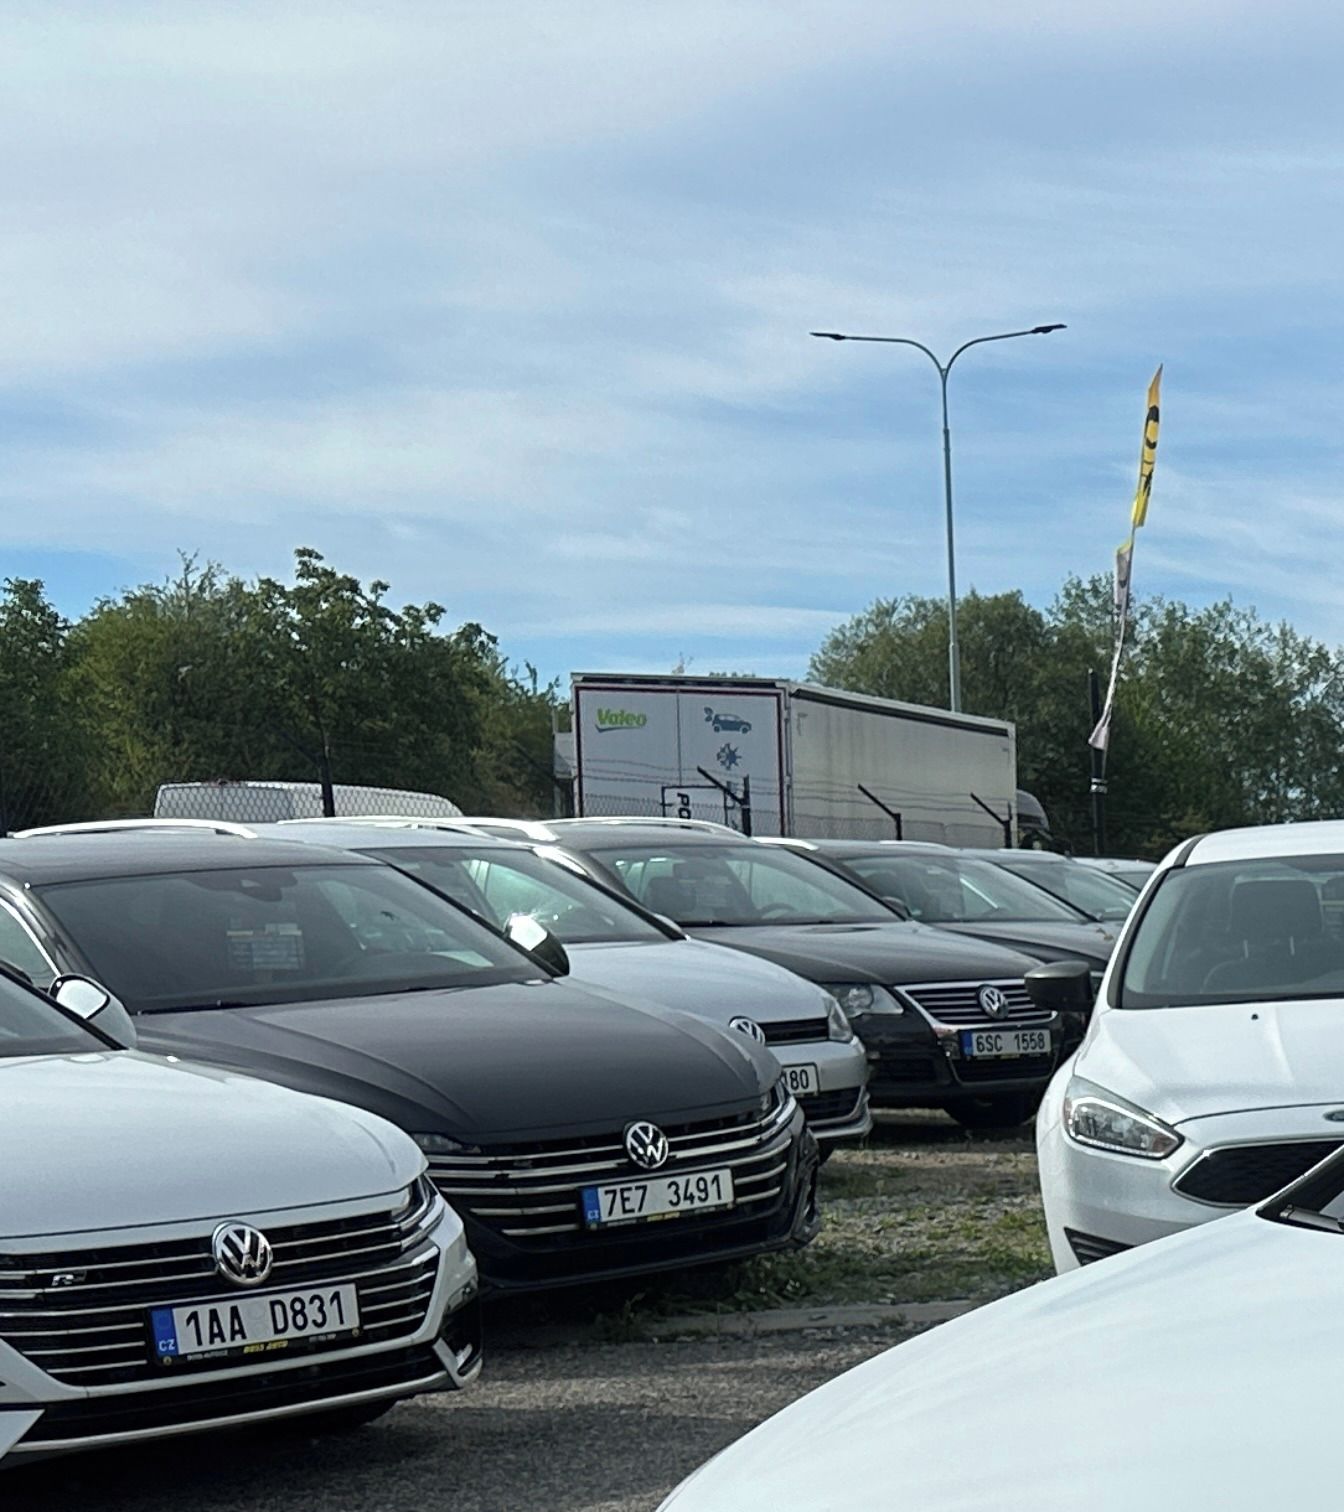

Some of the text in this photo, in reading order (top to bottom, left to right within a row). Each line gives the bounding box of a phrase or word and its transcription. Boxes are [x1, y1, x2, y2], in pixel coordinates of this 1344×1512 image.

[597, 708, 648, 726] Valeo
[976, 1032, 1045, 1053] 6SC 1558
[604, 1174, 723, 1218] 7E7 3491
[186, 1290, 345, 1346] 1AA D831
[158, 1339, 176, 1352] CZ
